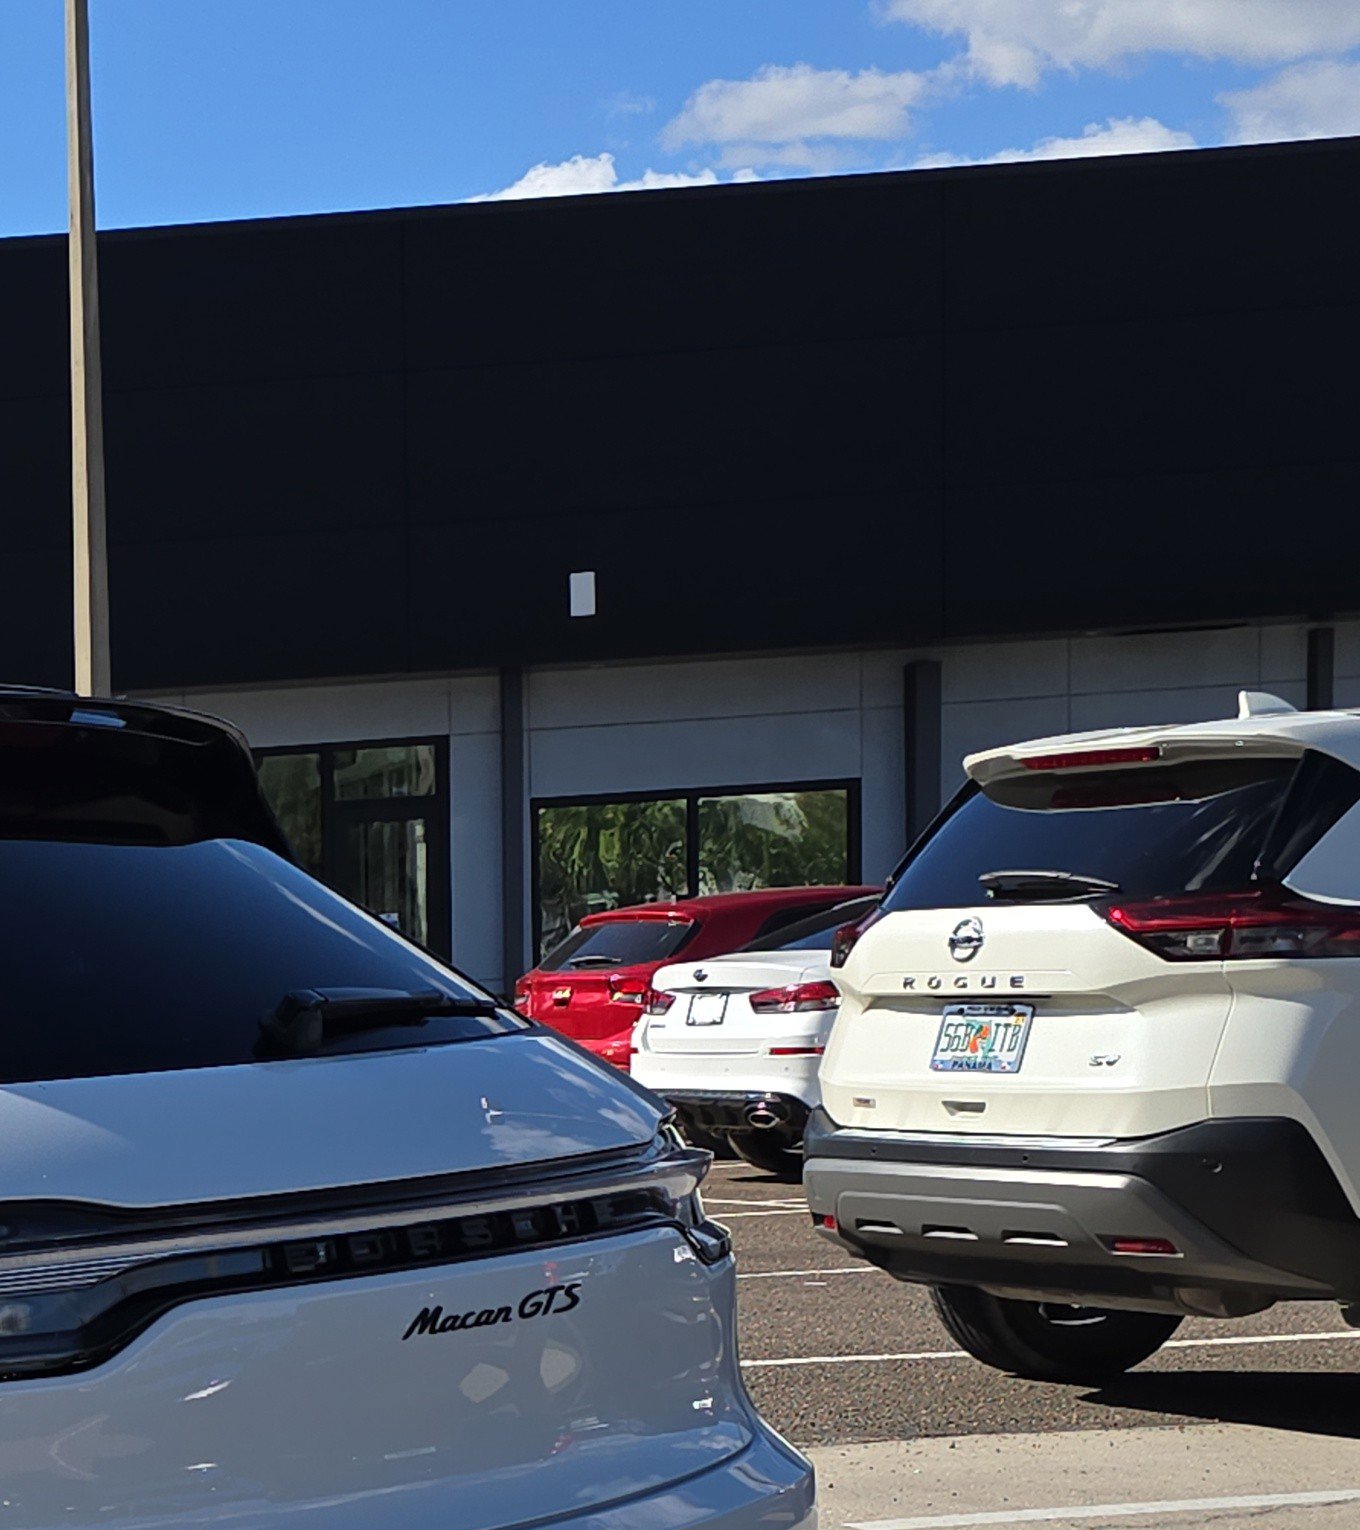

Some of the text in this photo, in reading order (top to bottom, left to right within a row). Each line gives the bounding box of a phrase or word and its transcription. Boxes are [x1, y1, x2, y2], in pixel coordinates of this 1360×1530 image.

[903, 976, 1024, 989] ROGUE
[1089, 1055, 1121, 1066] SV
[402, 1283, 582, 1341] Macan GTS
